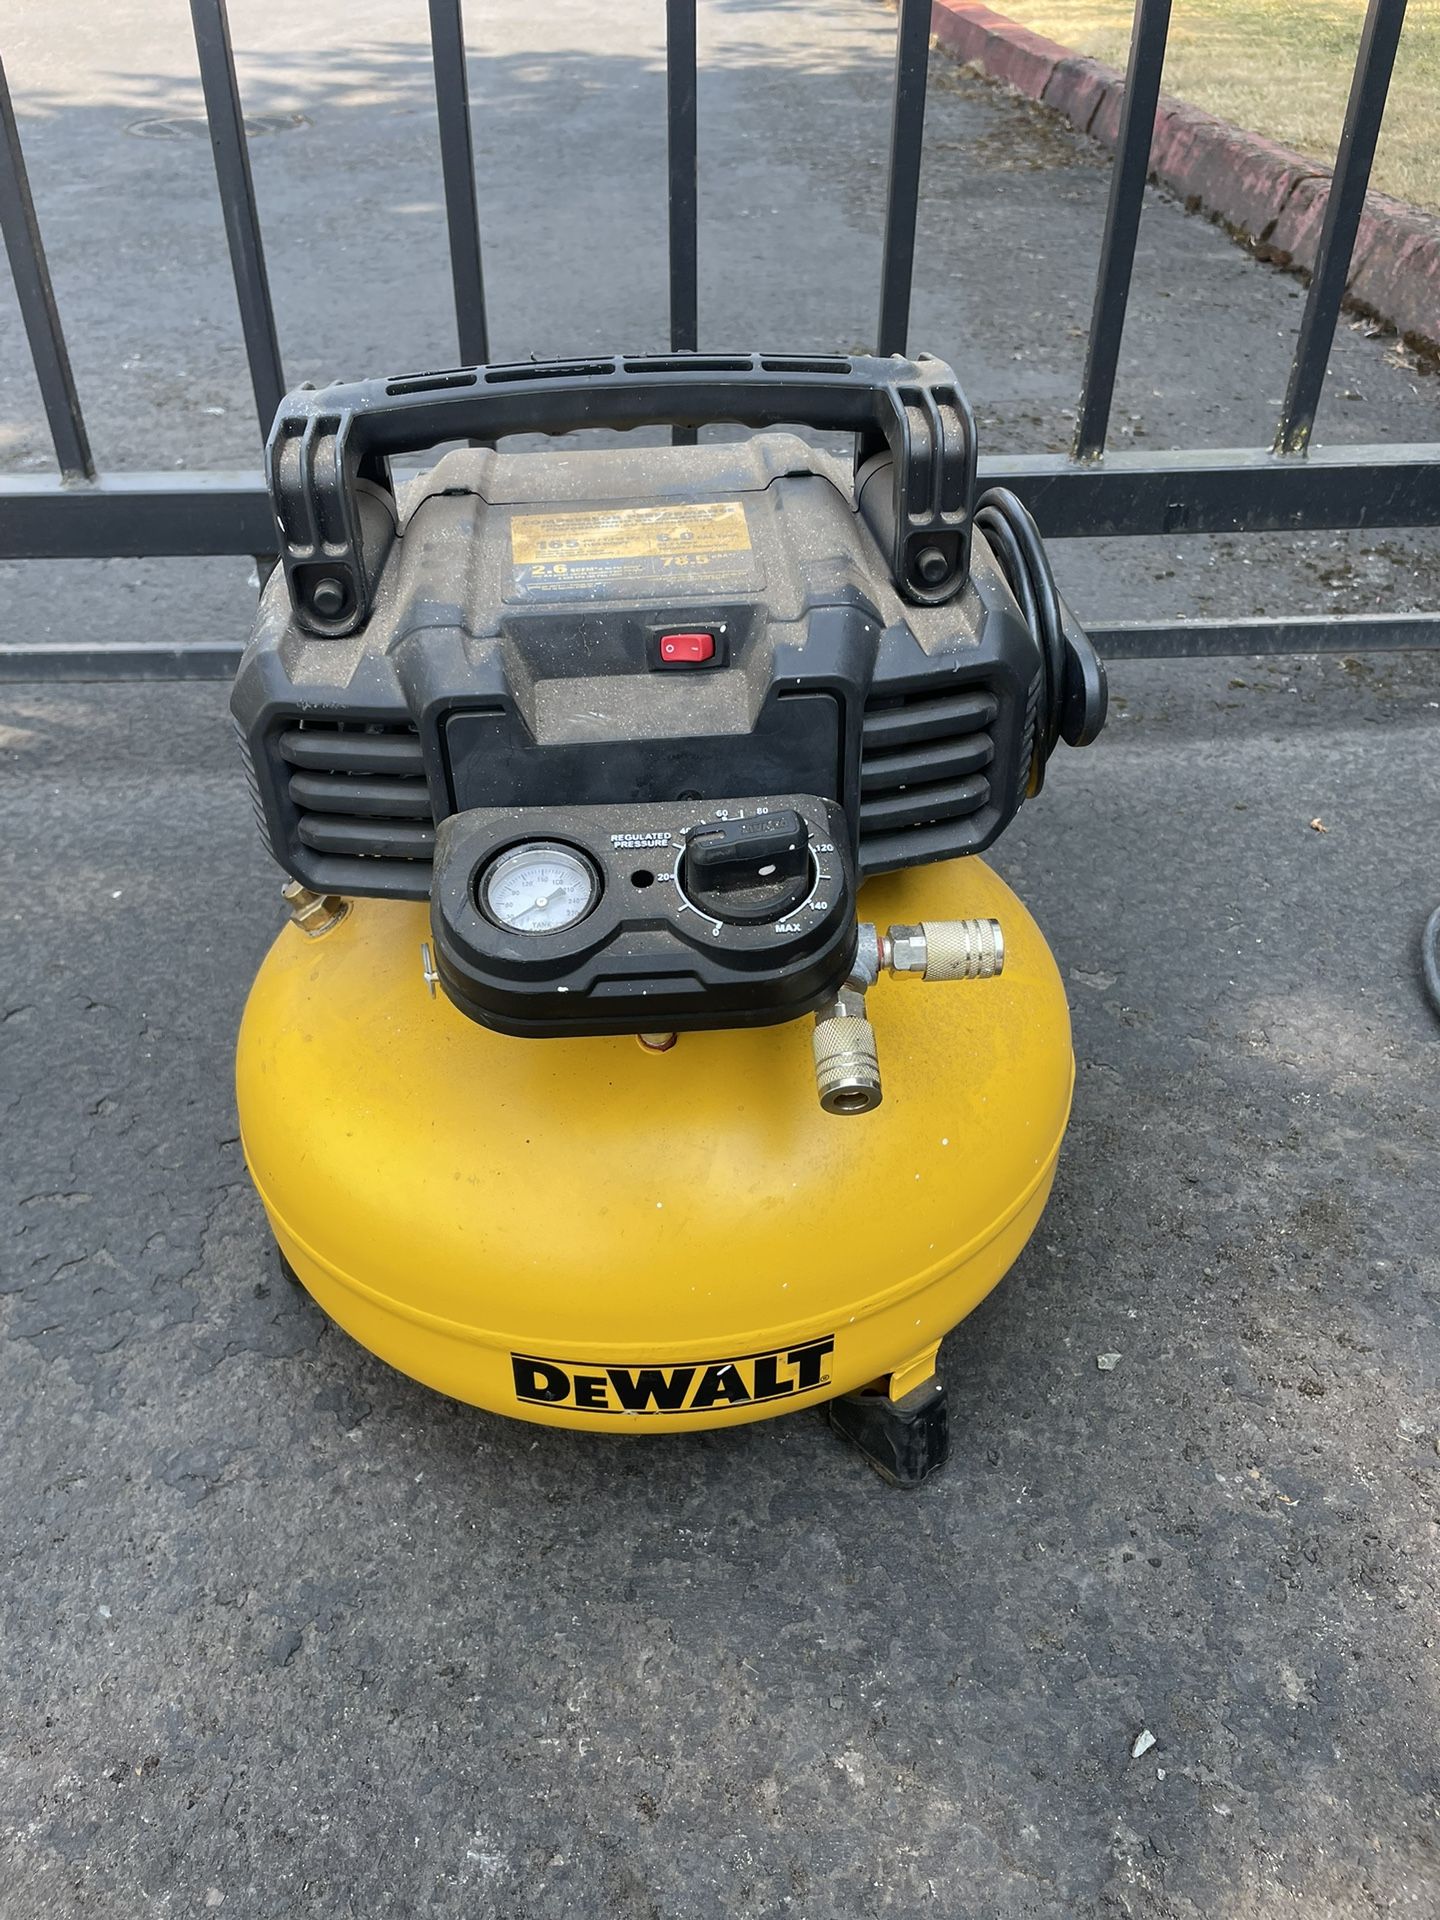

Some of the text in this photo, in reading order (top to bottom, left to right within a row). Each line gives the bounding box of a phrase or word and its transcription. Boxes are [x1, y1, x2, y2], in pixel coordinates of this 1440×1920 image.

[531, 563, 568, 576] 2.6
[715, 809, 729, 818] 60
[756, 807, 769, 816] 80
[610, 832, 671, 842] REGULATED
[614, 840, 669, 849] PRESSURE
[816, 844, 834, 853] 120
[657, 873, 670, 882] 20
[810, 901, 828, 911] 140
[712, 928, 720, 937] 0
[775, 923, 802, 934] MAX
[511, 1341, 834, 1410] DEWALT
